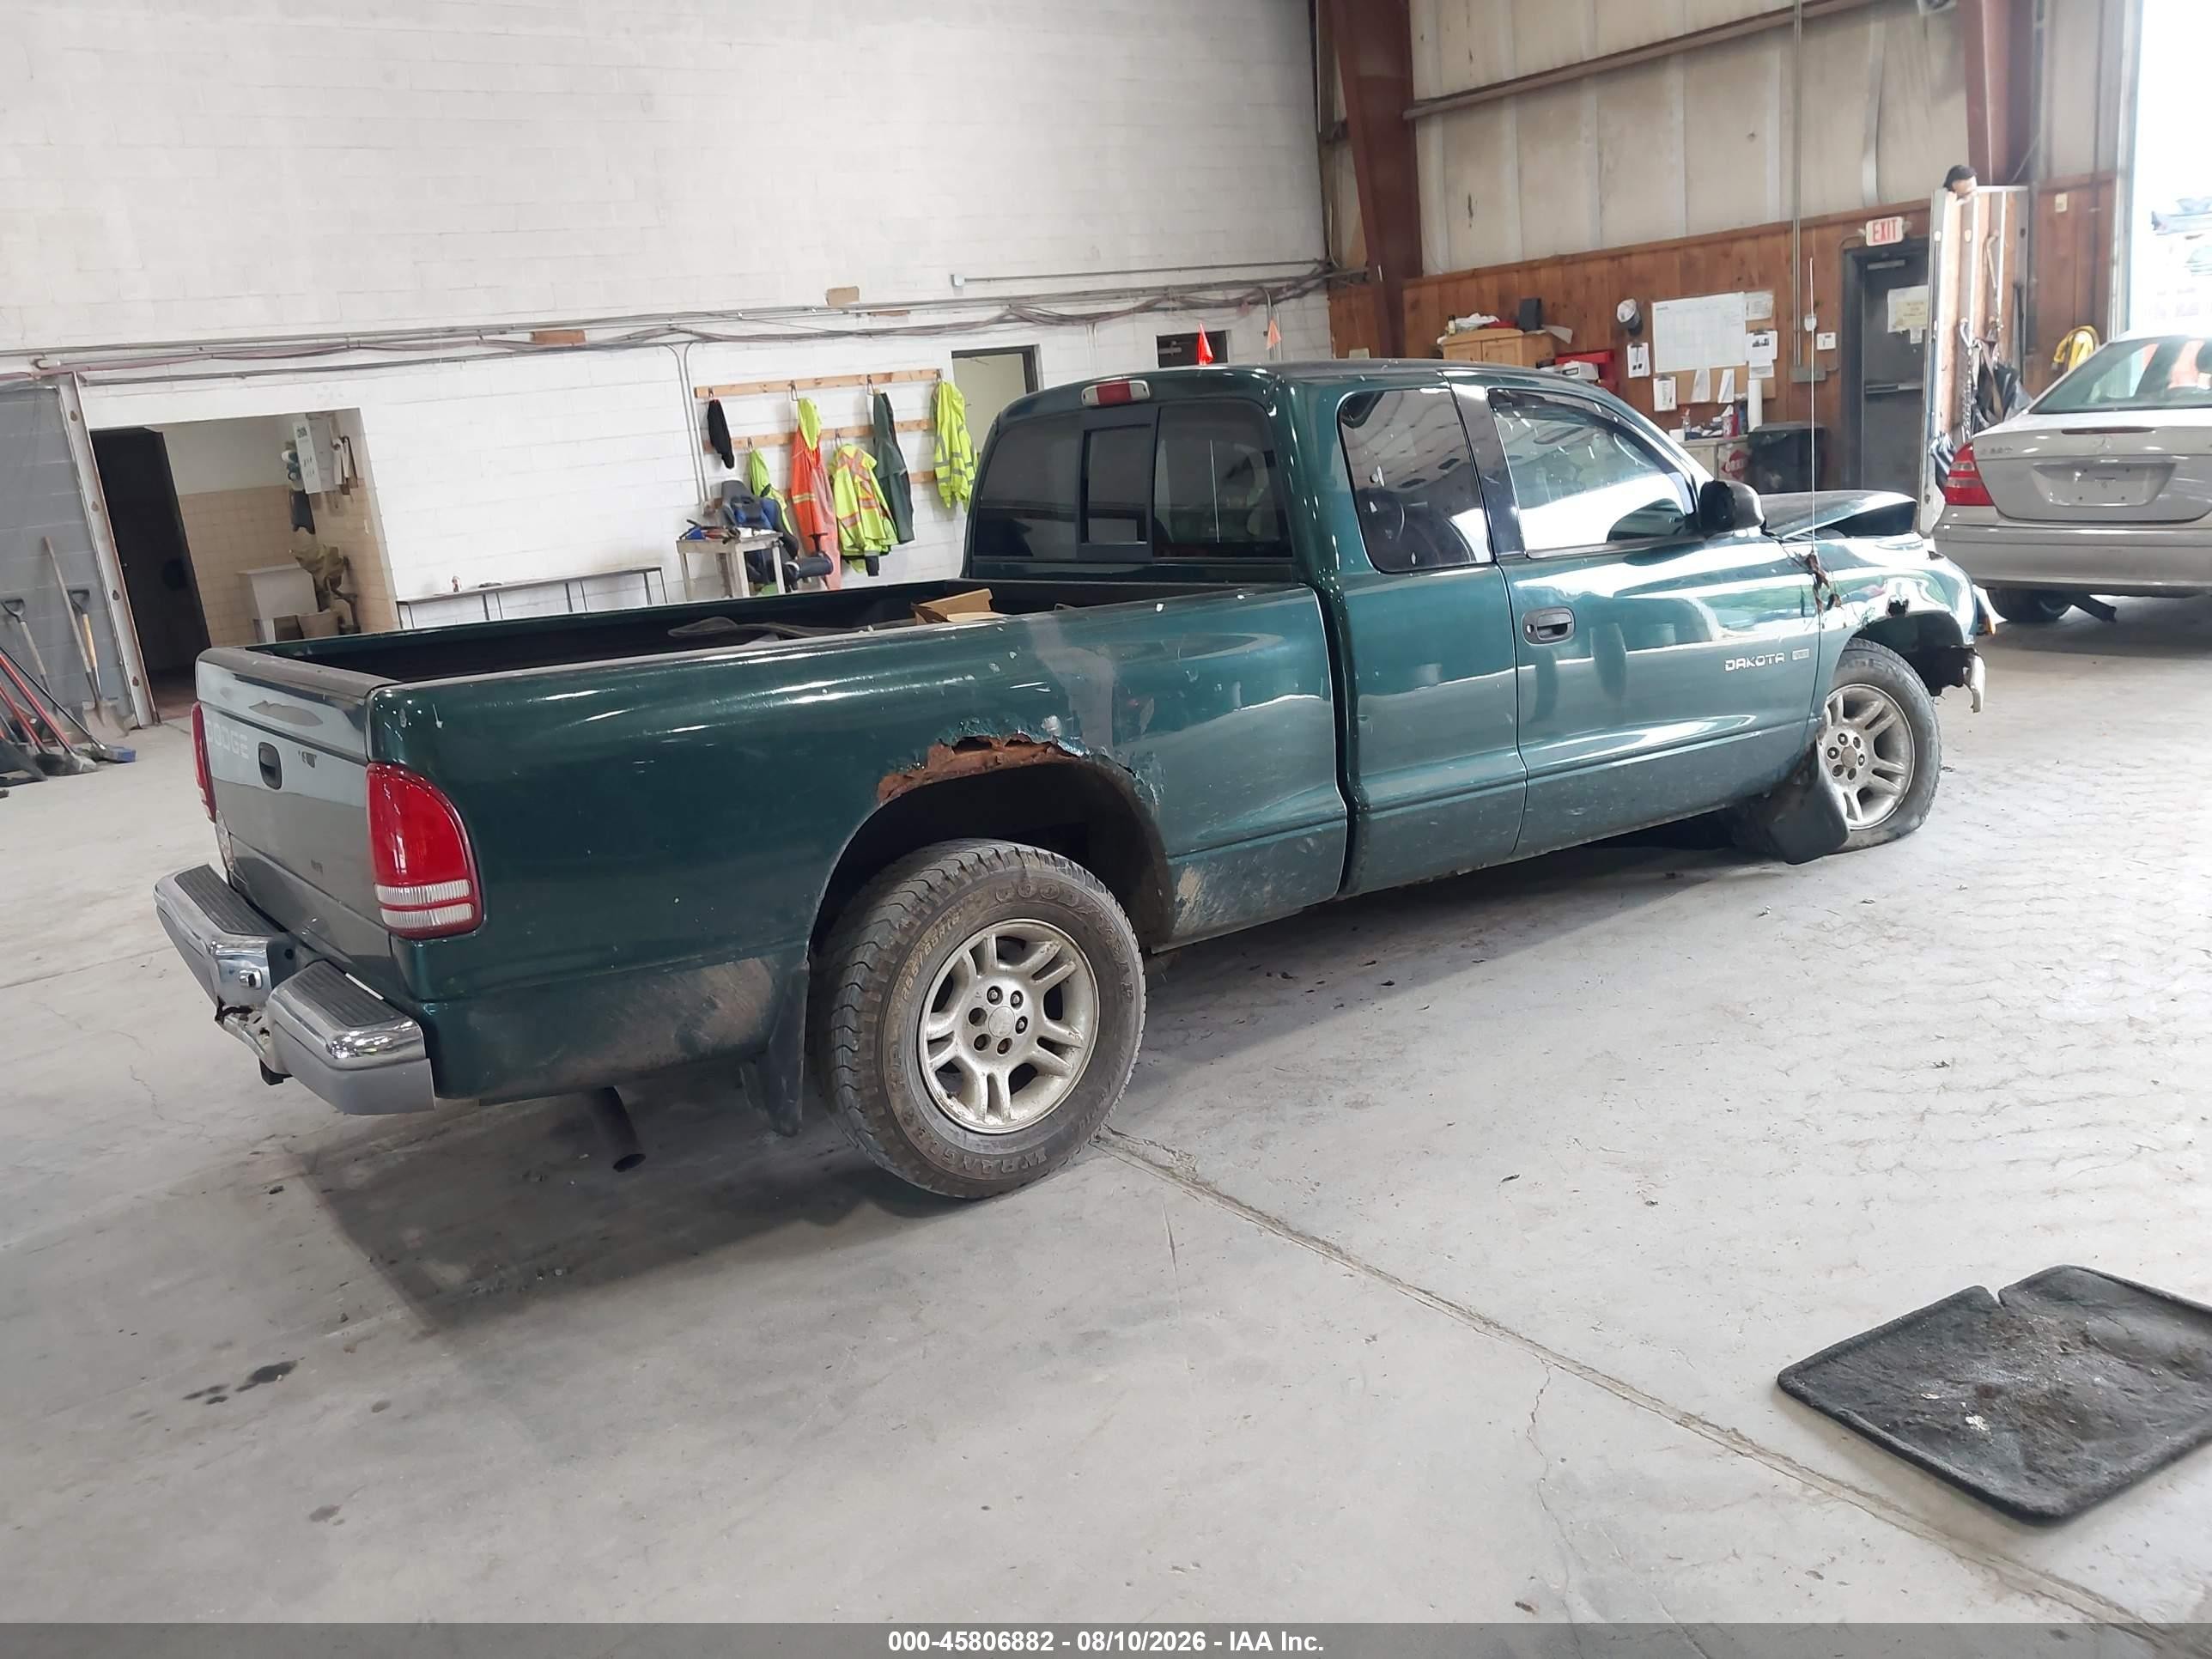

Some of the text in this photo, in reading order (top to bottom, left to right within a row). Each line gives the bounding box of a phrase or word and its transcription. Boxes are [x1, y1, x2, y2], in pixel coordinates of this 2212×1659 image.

[1872, 219, 1897, 243] EXIT
[1724, 652, 1785, 672] DAKOTA
[204, 719, 249, 759] DODGE
